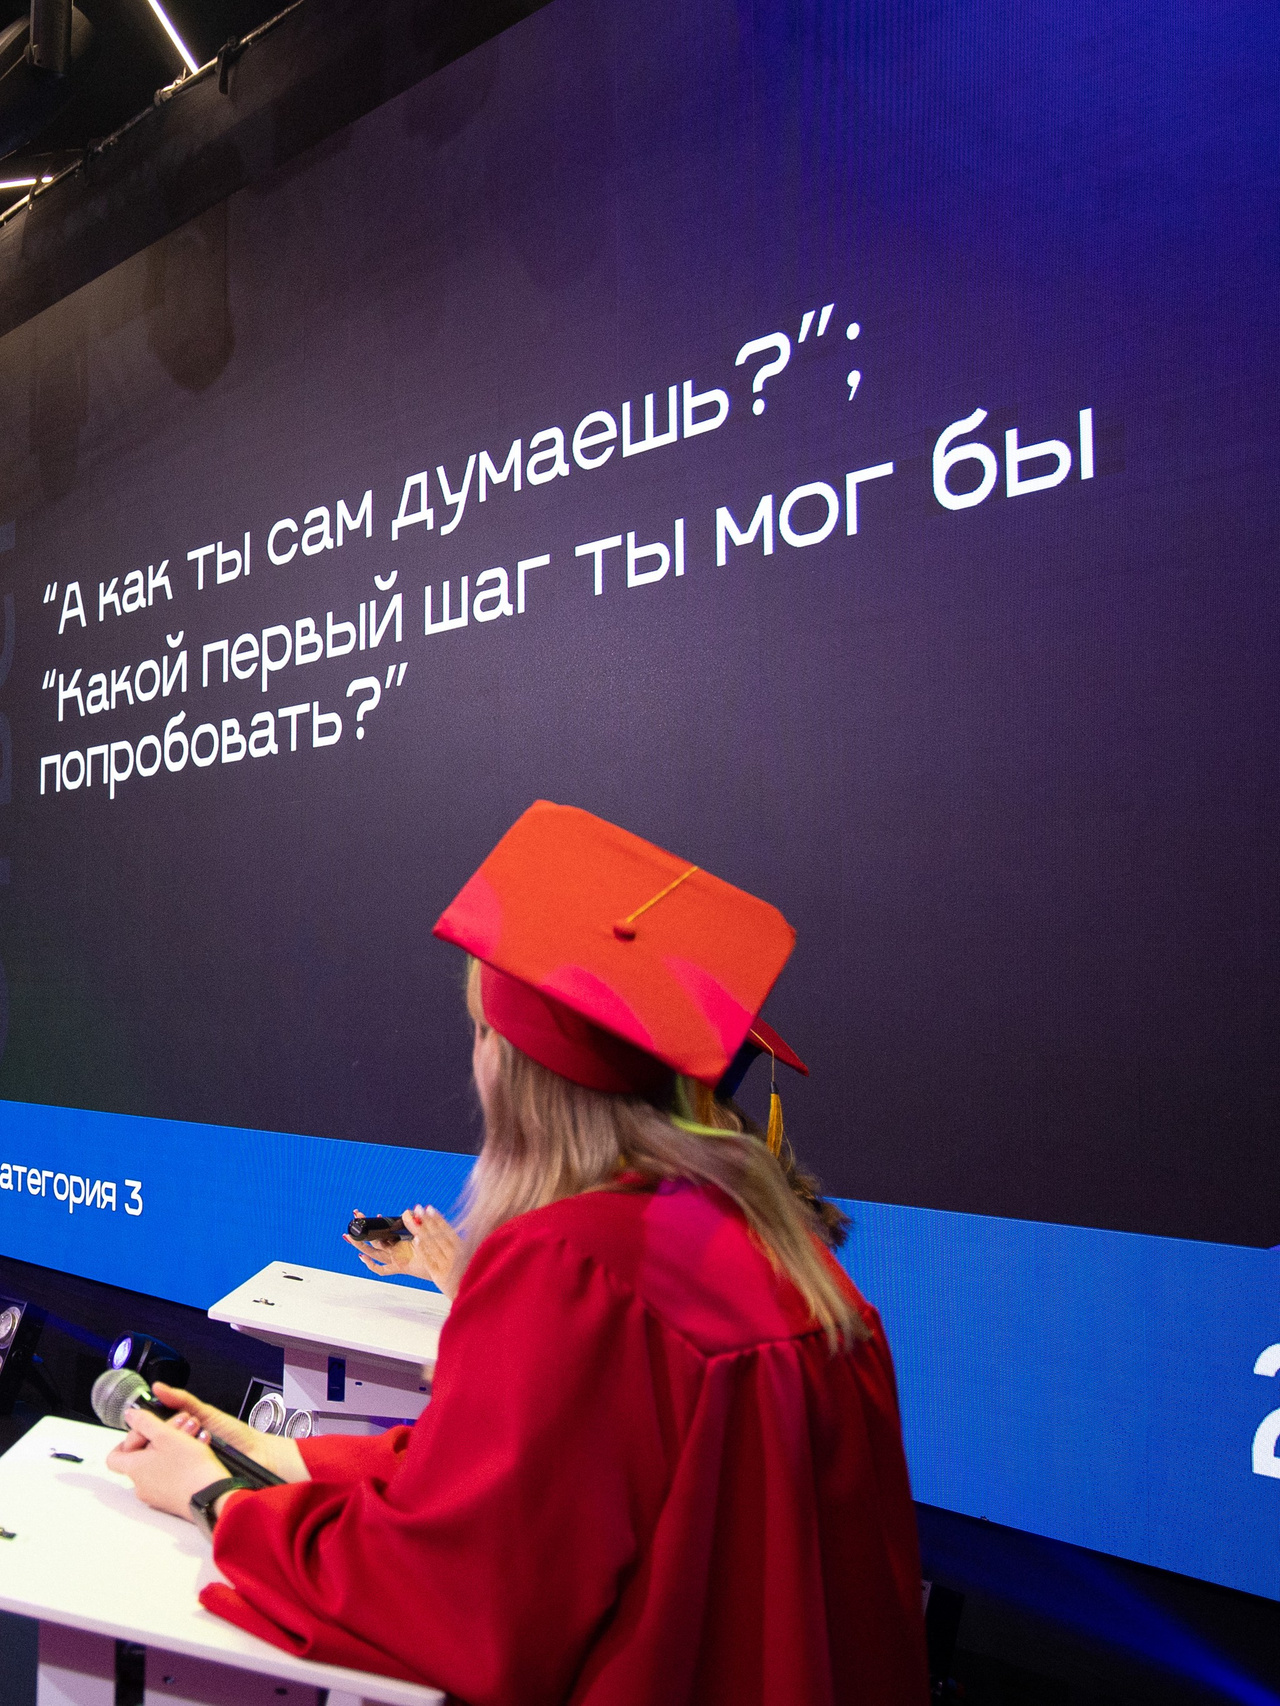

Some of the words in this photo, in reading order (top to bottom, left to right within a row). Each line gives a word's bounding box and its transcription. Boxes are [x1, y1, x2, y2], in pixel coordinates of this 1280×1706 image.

[41, 631, 188, 725] “Какой
[203, 570, 404, 693] первый
[425, 553, 552, 636] шаг
[575, 518, 686, 596] ты
[715, 461, 895, 567] мог
[932, 407, 1095, 511] бы
[42, 582, 87, 635] “А
[99, 560, 174, 622] как
[187, 532, 251, 591] ты
[268, 490, 373, 566] сам
[40, 661, 410, 801] попробовать?”
[124, 1179, 143, 1216] 3
